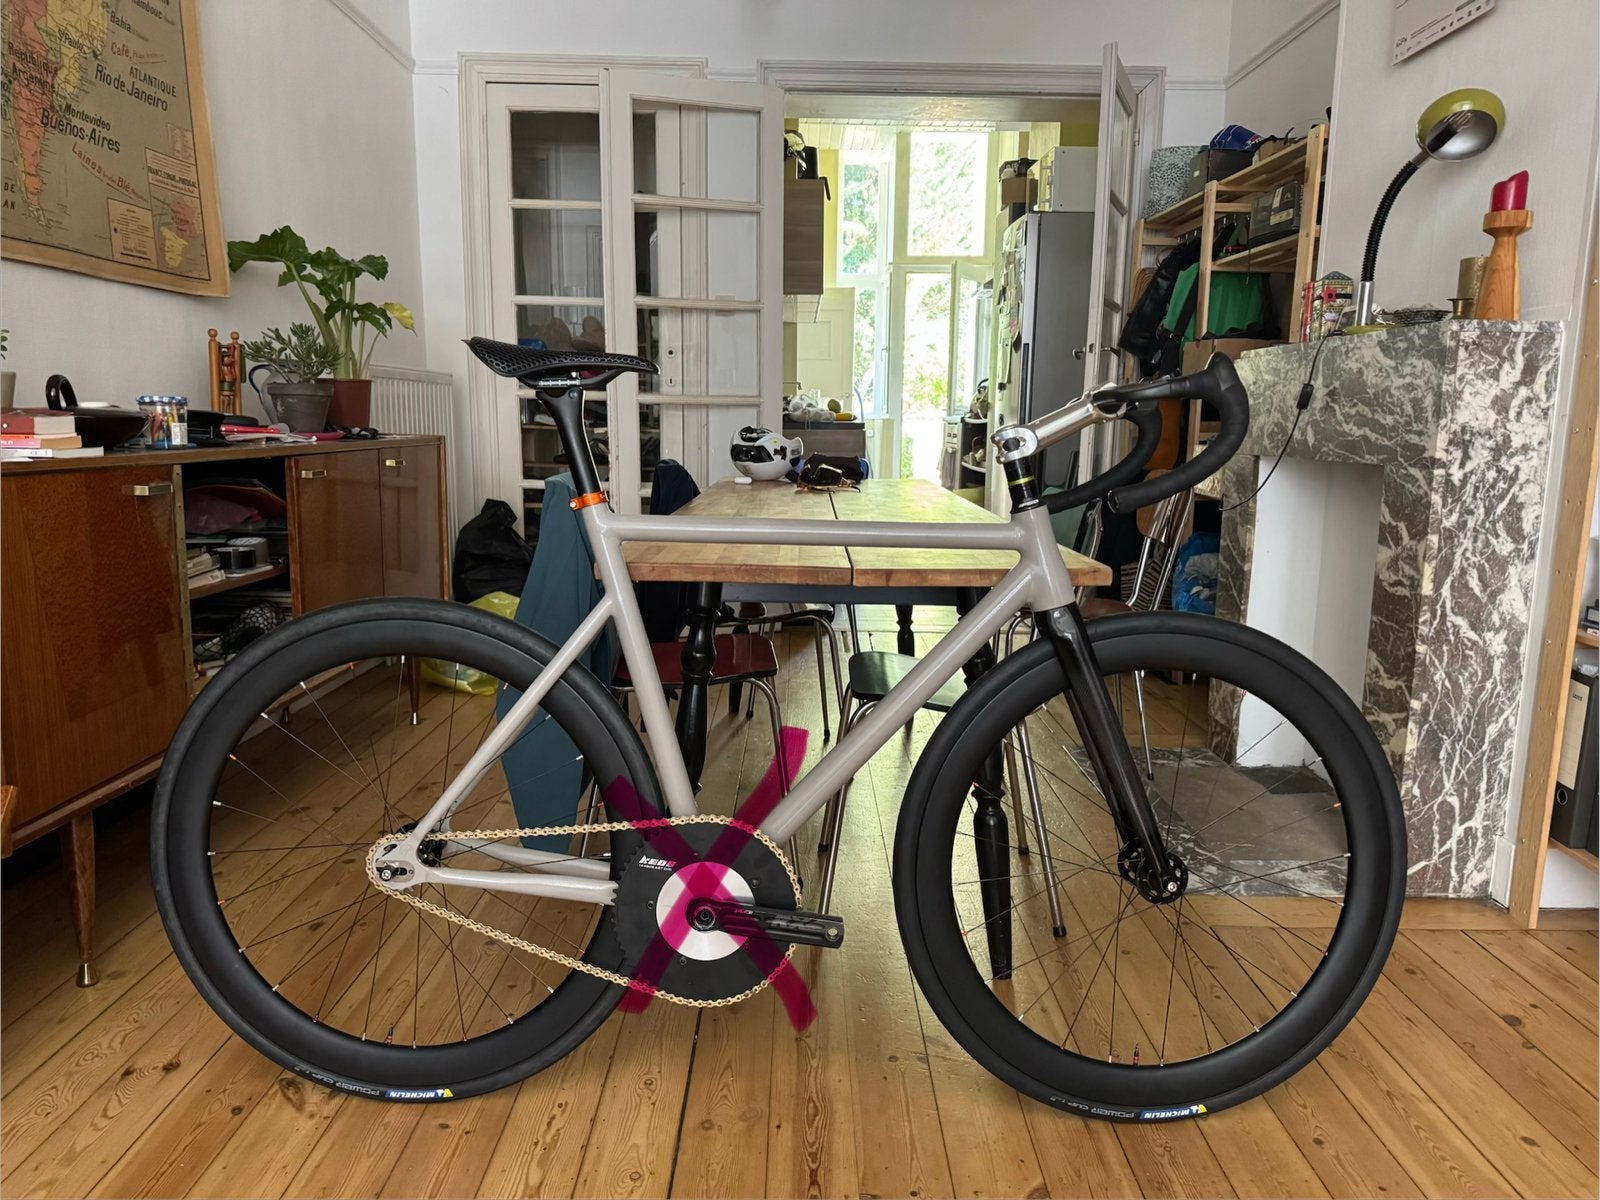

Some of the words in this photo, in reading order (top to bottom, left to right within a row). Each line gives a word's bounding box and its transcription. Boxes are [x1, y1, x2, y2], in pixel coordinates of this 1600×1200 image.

[110, 11, 132, 33] Bahia
[95, 63, 112, 86] Rio
[113, 74, 126, 93] de
[126, 81, 168, 112] Janeiro
[129, 66, 177, 98] ATLANTIQUE
[64, 102, 111, 131] Montevideo
[312, 1072, 334, 1085] CUP
[335, 1080, 380, 1096] POWER
[389, 1089, 436, 1099] MICHELIN
[1067, 1101, 1090, 1110] CUP
[1091, 1107, 1135, 1119] POWER
[1144, 1108, 1190, 1119] MICHELIN
